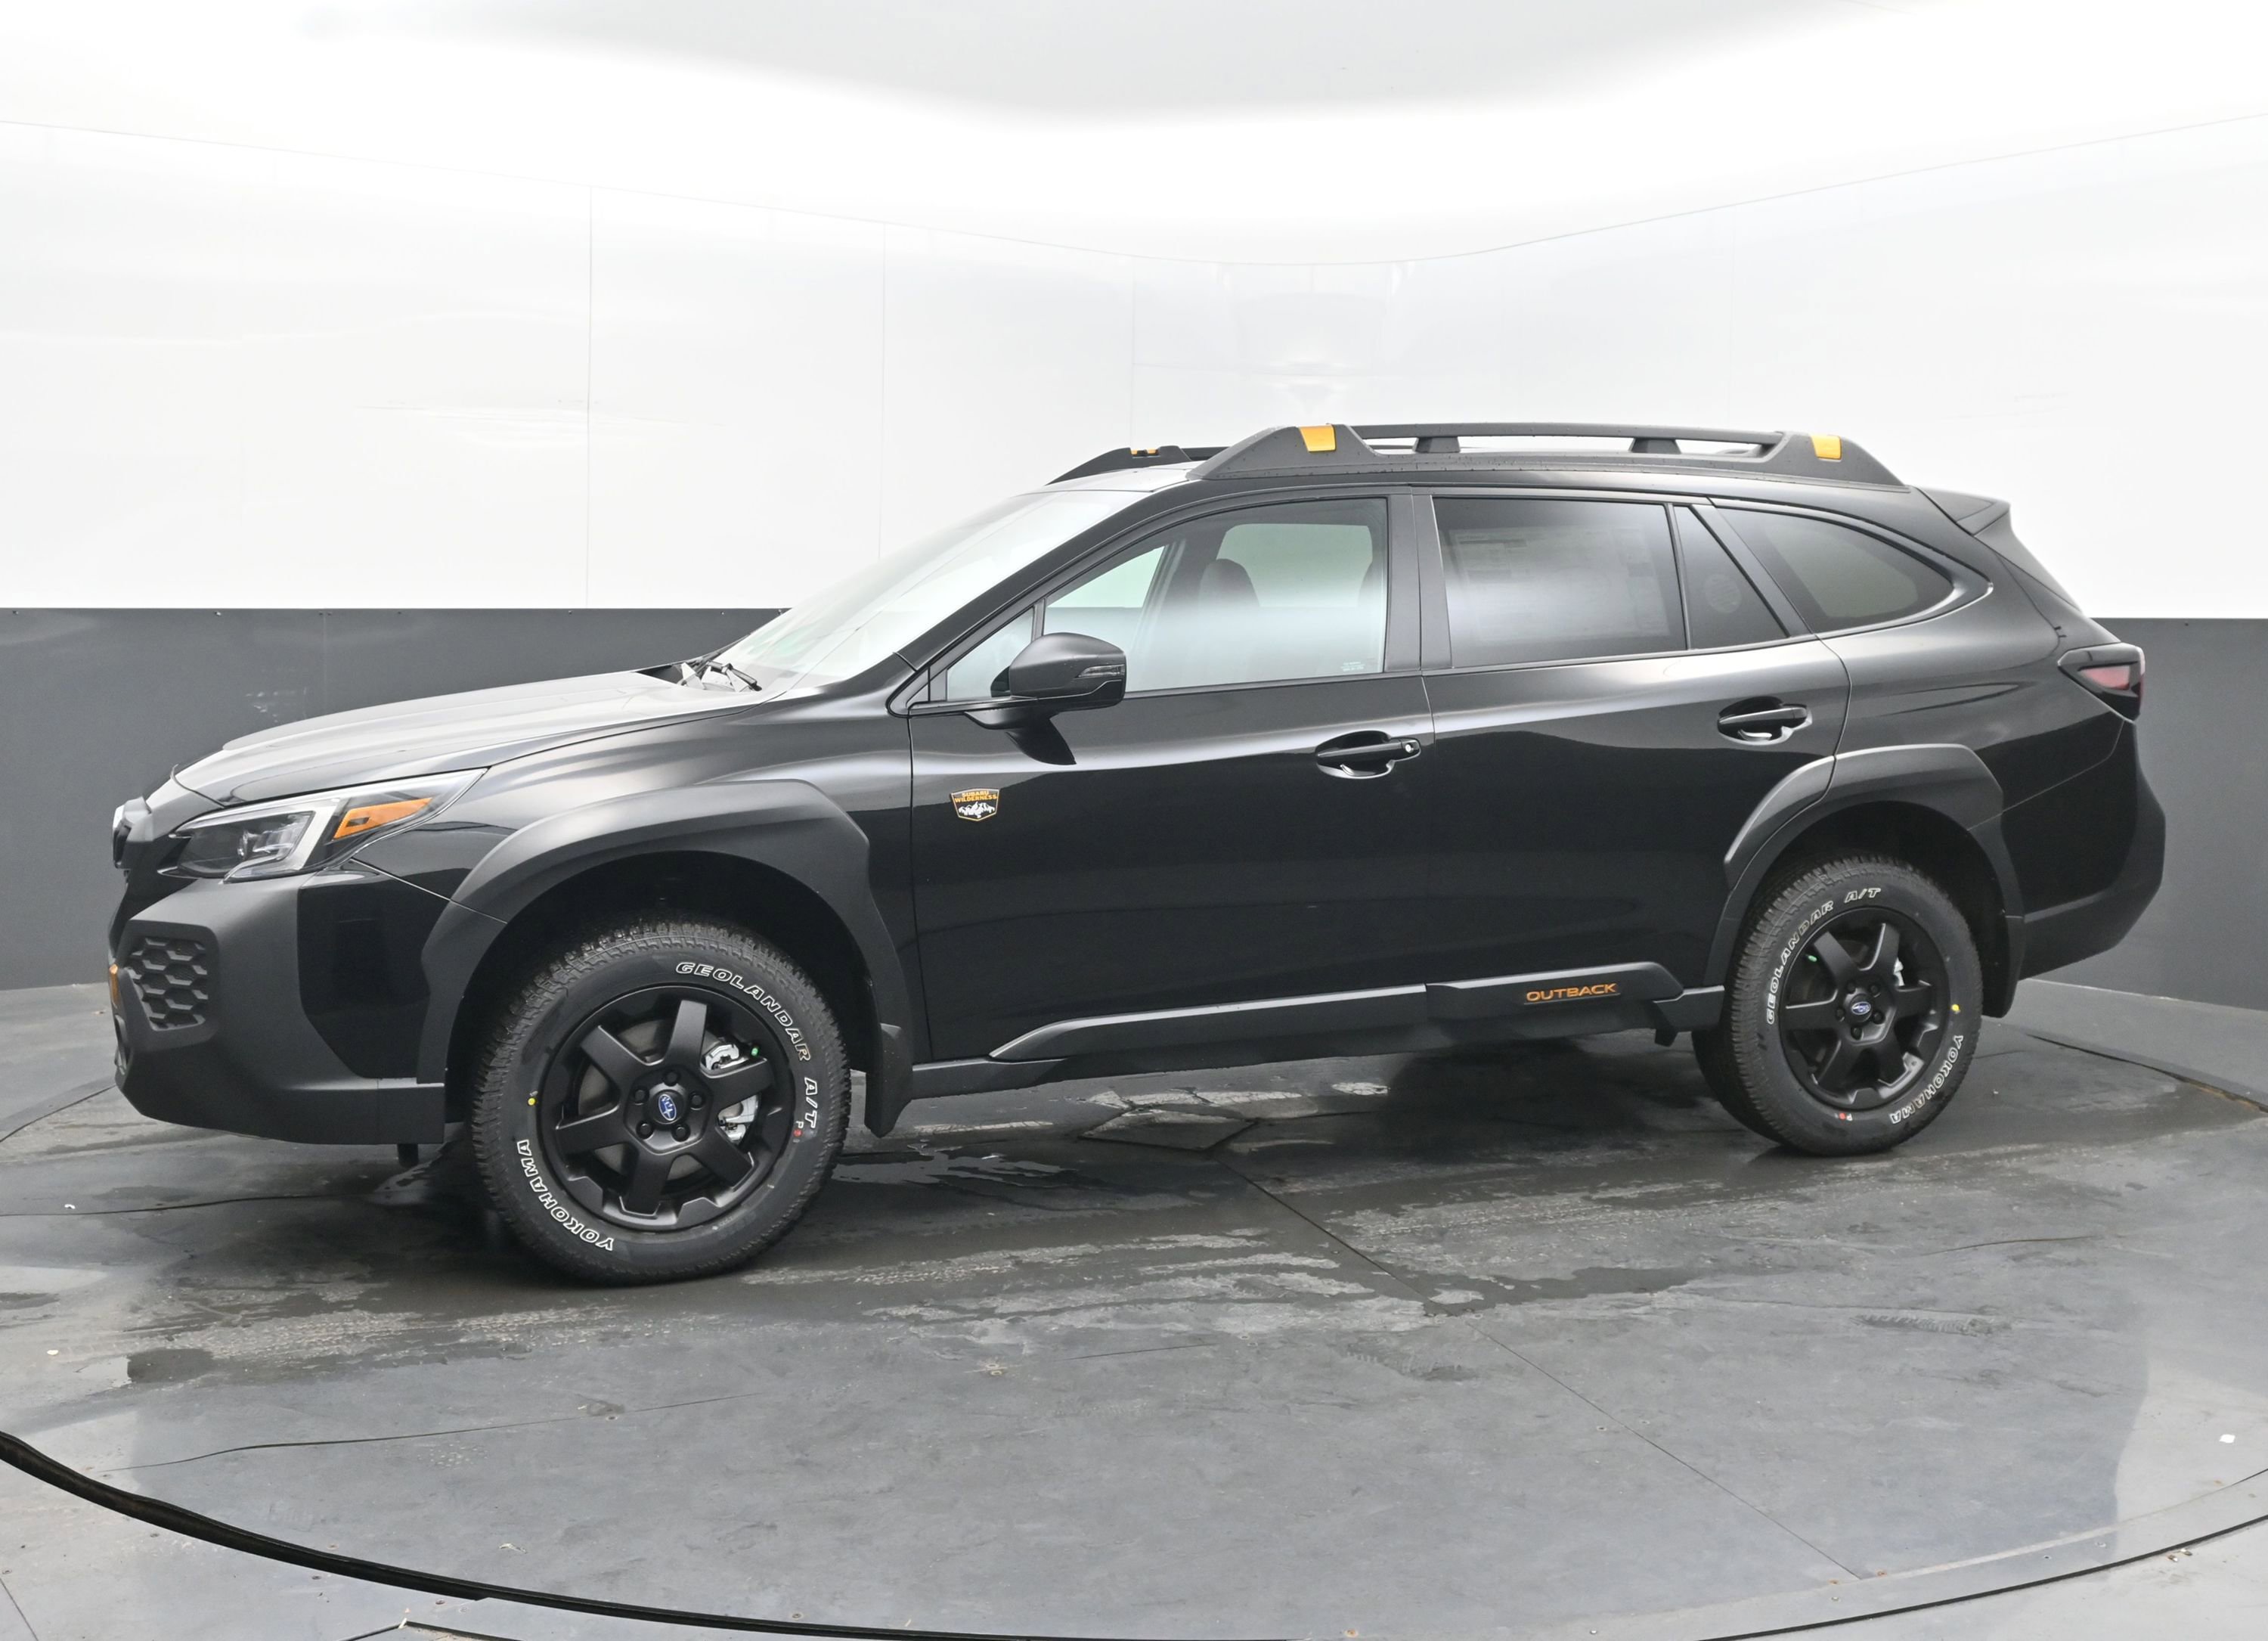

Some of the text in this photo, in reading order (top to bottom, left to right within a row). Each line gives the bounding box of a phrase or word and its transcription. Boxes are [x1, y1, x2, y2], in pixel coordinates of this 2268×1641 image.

[954, 794, 997, 802] WILDERNESS
[1526, 983, 1617, 1002] OUTBACK
[1767, 888, 1882, 1025] GEOLANDAR A/T
[676, 961, 818, 1129] GEOLANDAR A/T
[1889, 1035, 1964, 1125] YOKOHAMA
[517, 1139, 615, 1252] YOKOHAMA
